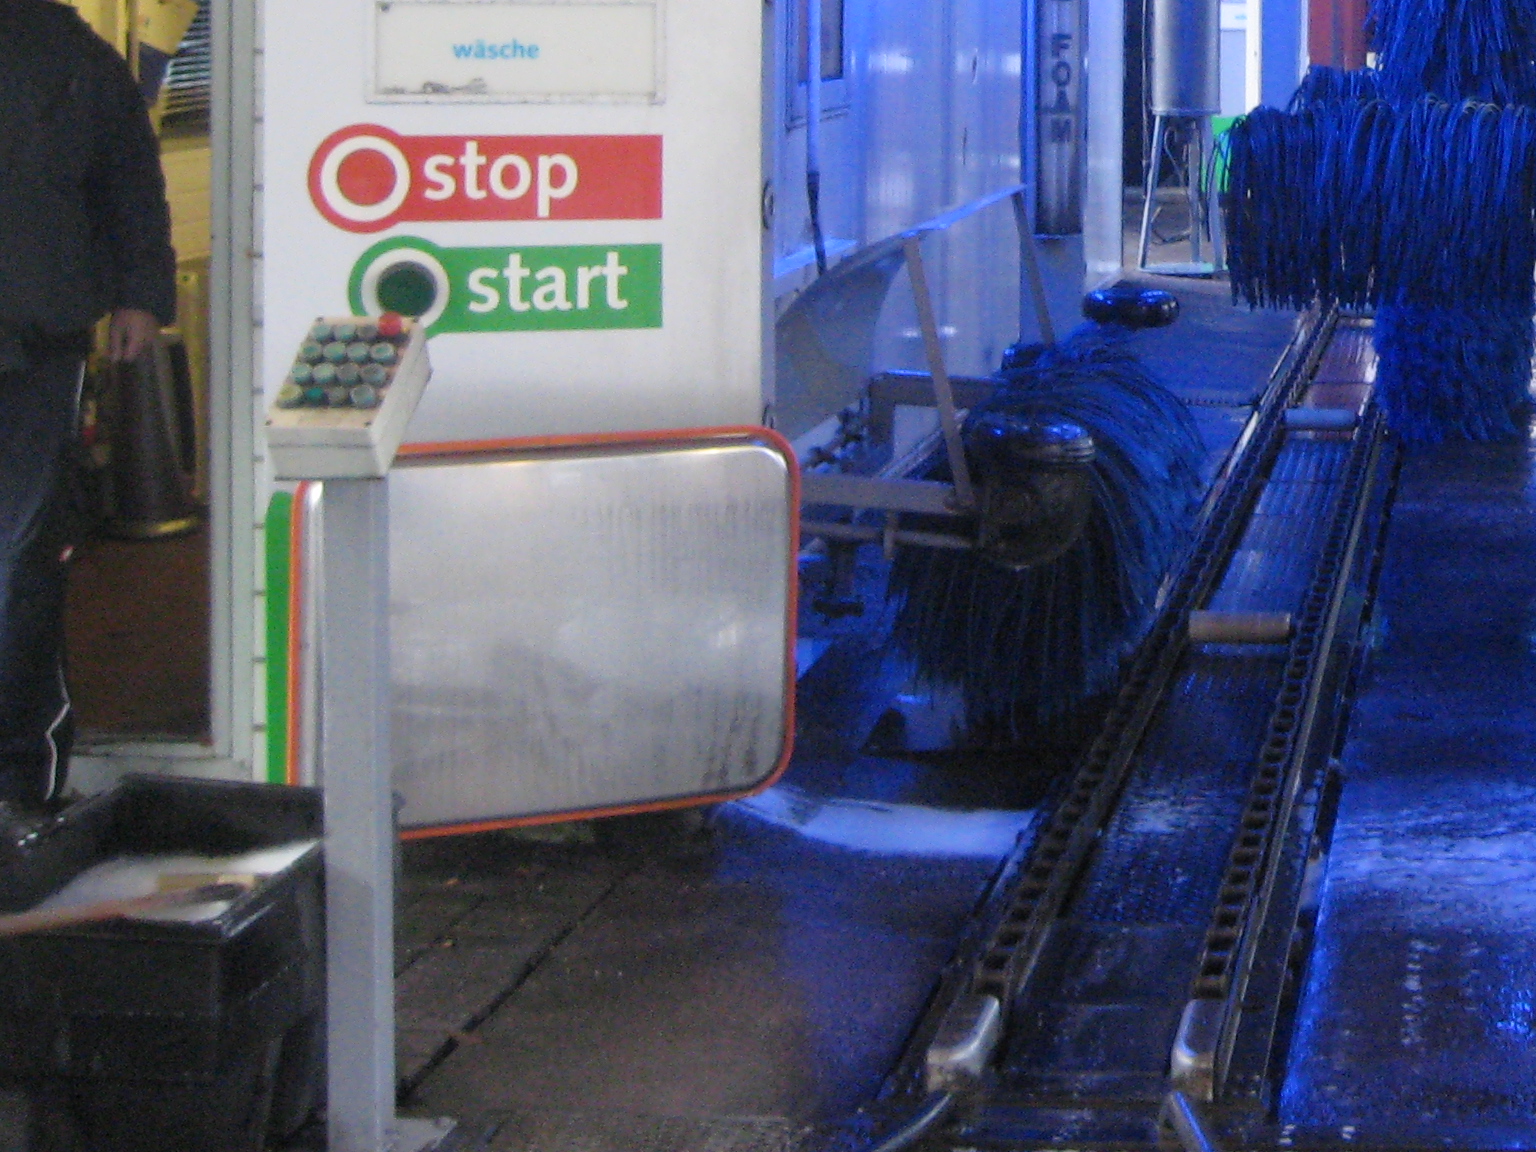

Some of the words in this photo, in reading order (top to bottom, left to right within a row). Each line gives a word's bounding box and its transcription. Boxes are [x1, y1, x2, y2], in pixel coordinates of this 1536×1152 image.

[453, 39, 539, 59] wäsche
[1052, 33, 1073, 143] FOAM
[424, 141, 577, 218] stop
[468, 252, 628, 312] start
